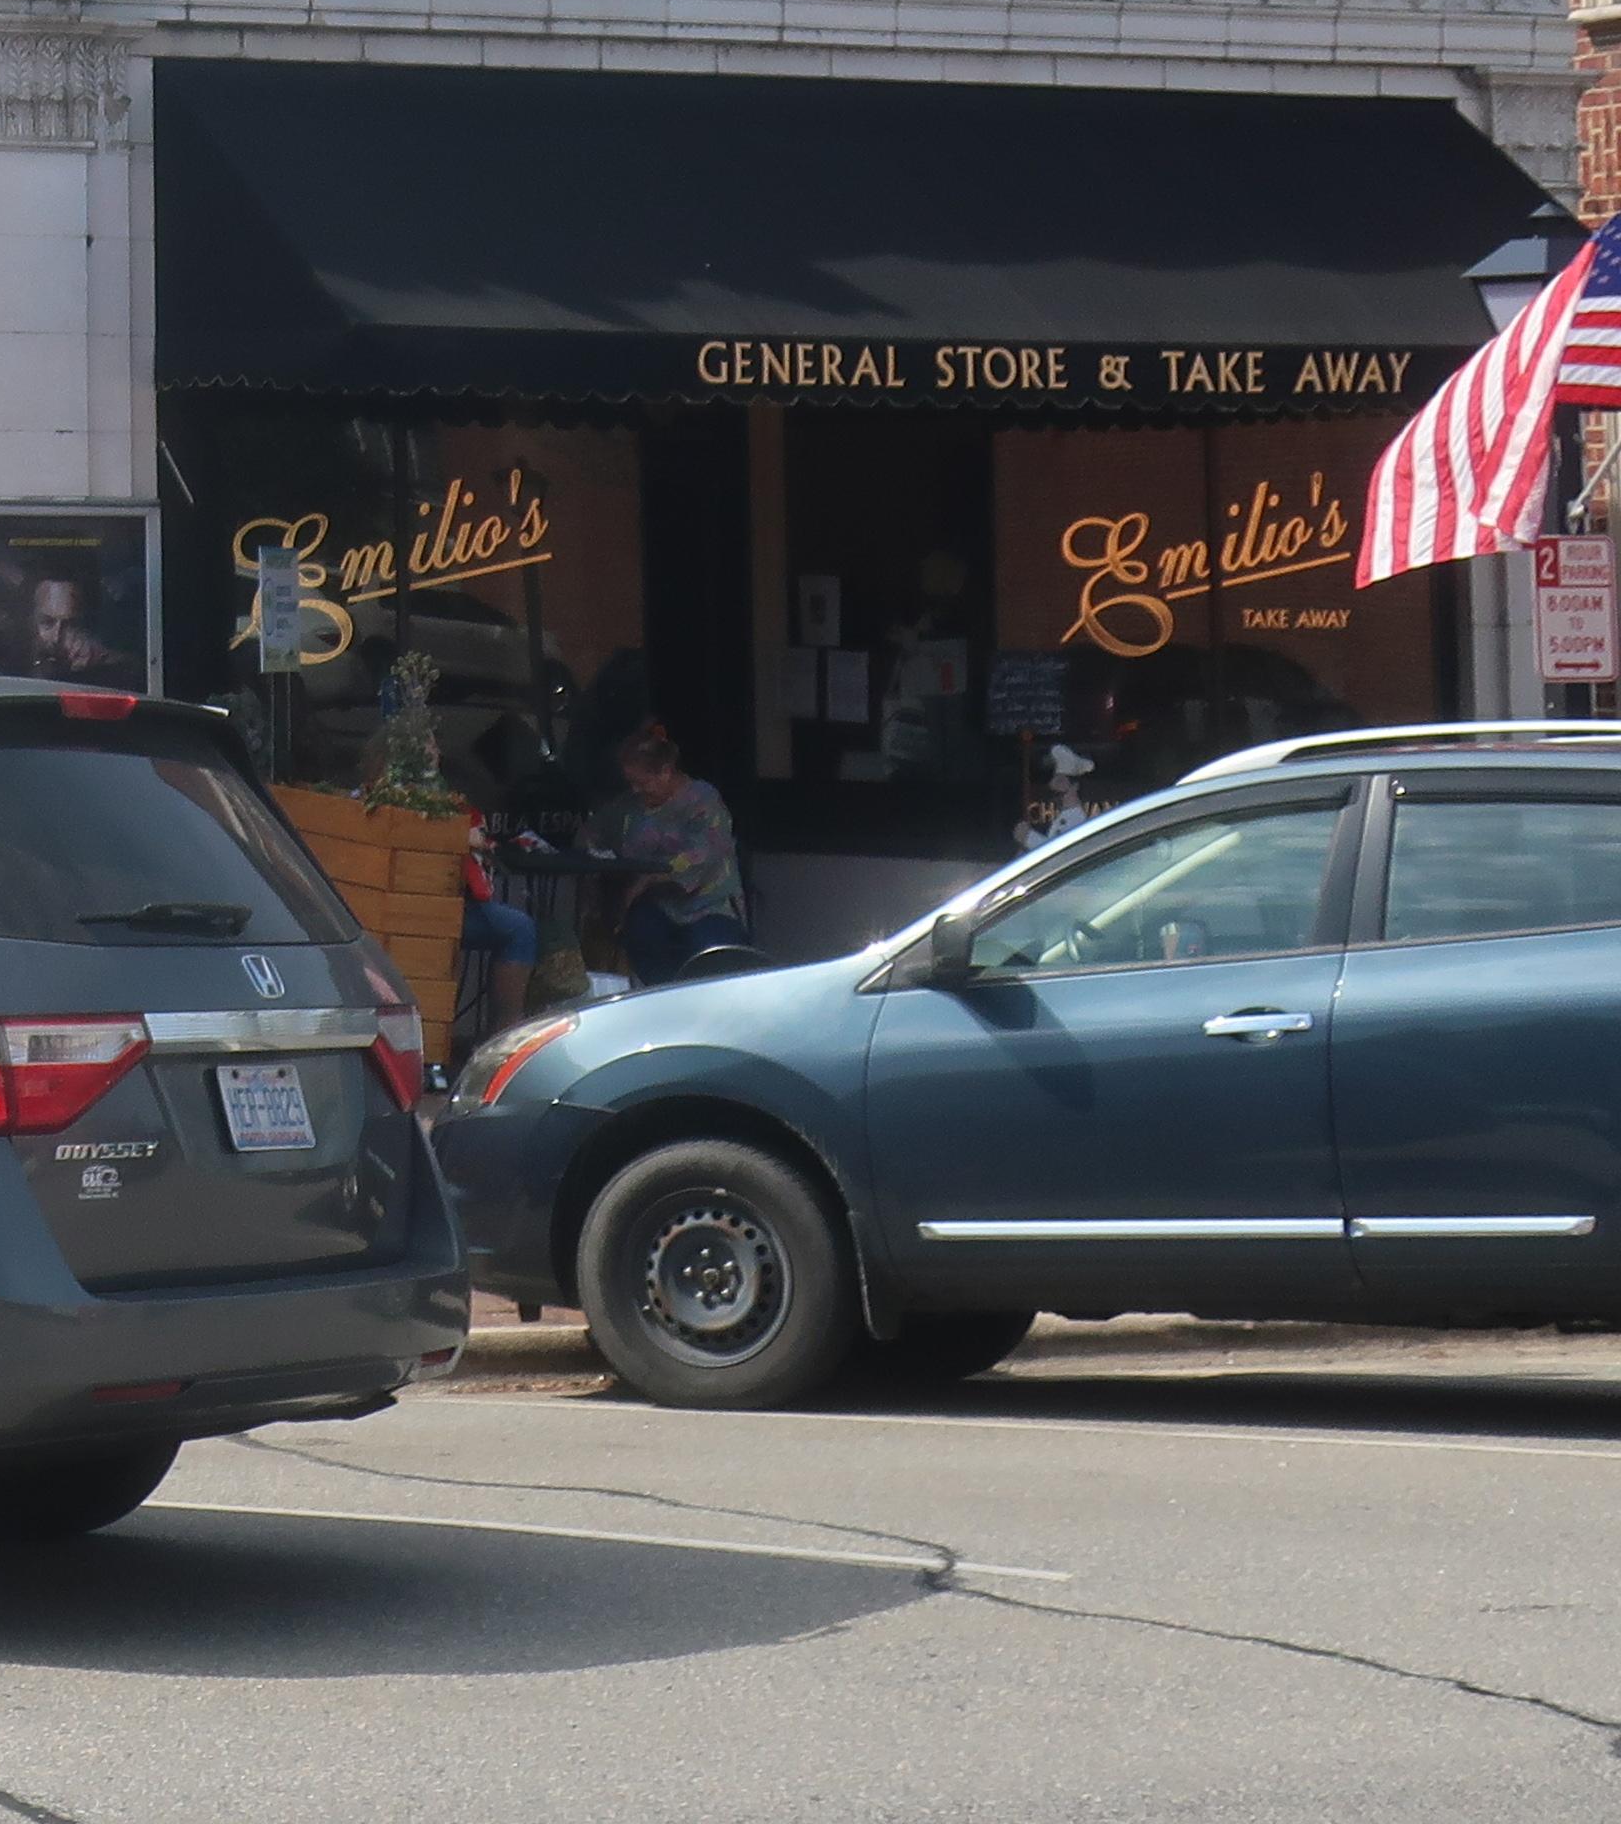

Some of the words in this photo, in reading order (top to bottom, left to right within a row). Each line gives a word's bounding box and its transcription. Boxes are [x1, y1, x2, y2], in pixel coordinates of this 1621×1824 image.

[697, 340, 906, 387] GENERAL
[936, 345, 1068, 390] STORE
[1099, 354, 1132, 390] &
[1161, 349, 1266, 392] TAKE
[1293, 351, 1413, 394] AWAY
[229, 468, 551, 665] Emilio's
[1060, 471, 1349, 658] Emilio's
[1538, 544, 1556, 580] 2
[1242, 607, 1290, 629] TAKE
[1293, 607, 1352, 630] AWAY
[54, 1140, 160, 1161] ODYSSEY
